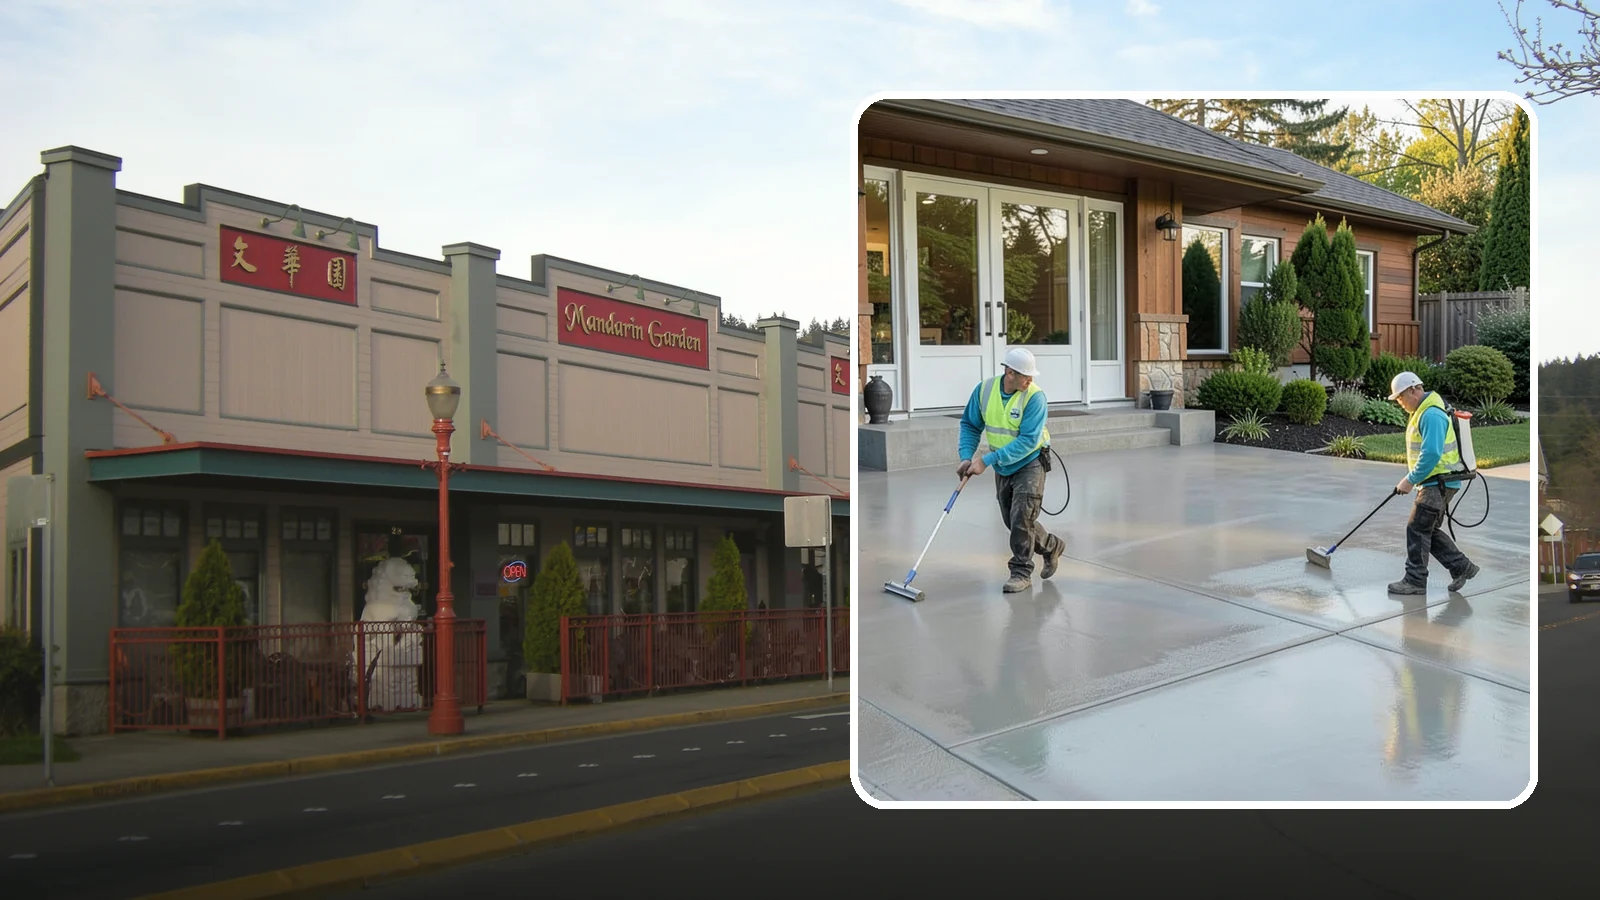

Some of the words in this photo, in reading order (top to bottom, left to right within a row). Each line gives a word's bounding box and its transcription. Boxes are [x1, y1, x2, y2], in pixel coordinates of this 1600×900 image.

[564, 302, 644, 341] Mandarin
[648, 320, 701, 352] Garden
[503, 565, 527, 578] OPEN
